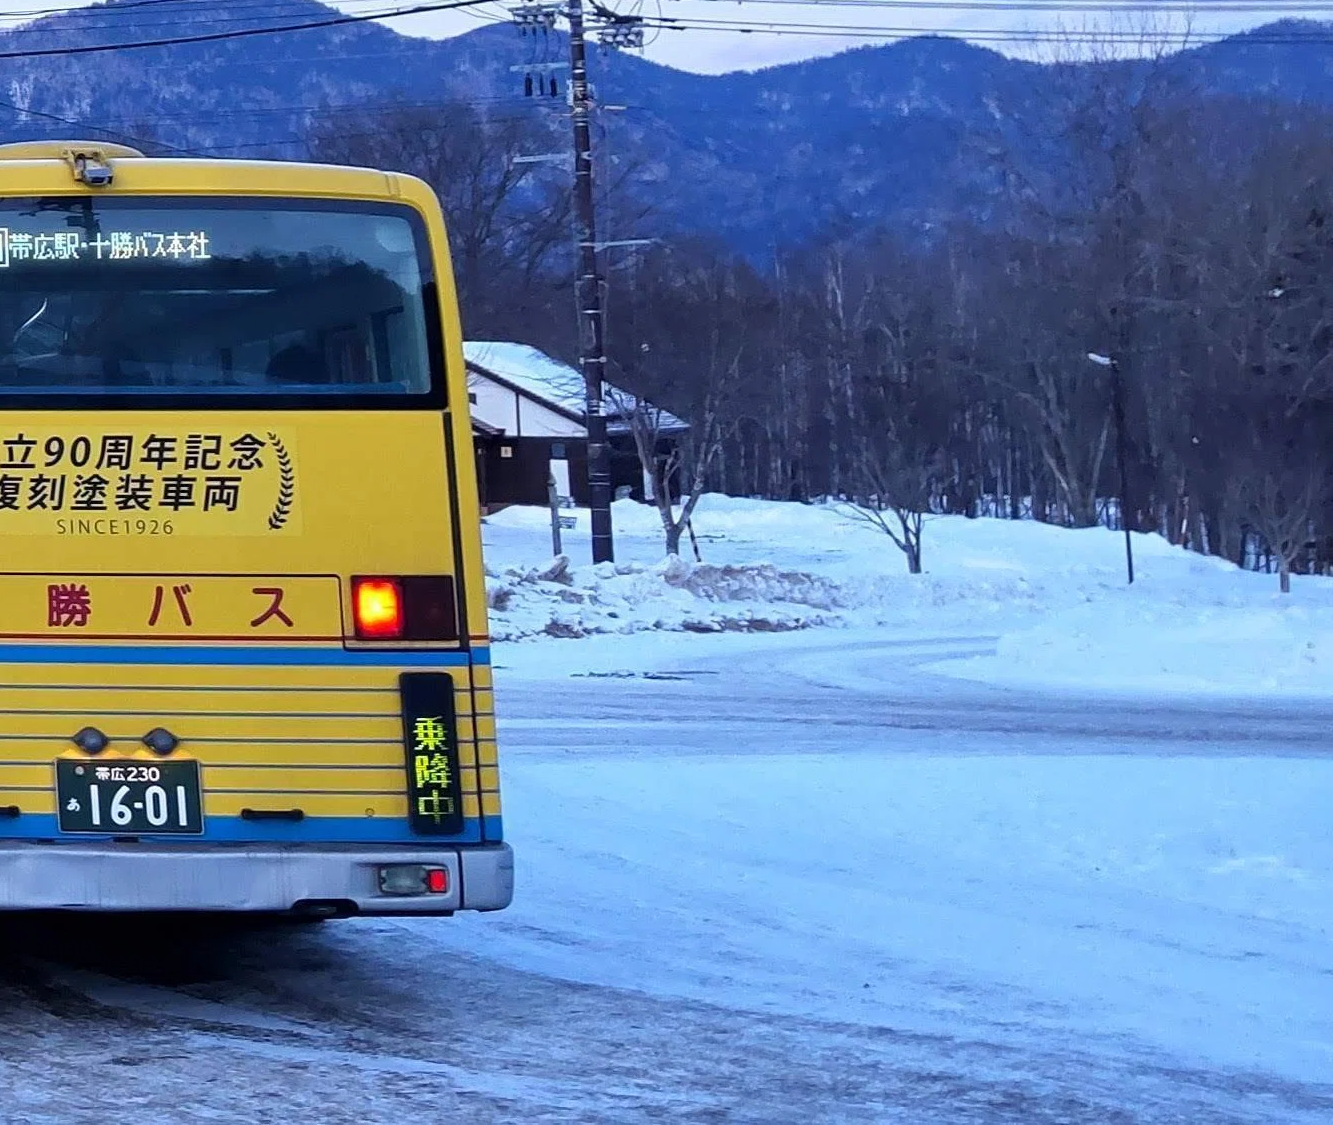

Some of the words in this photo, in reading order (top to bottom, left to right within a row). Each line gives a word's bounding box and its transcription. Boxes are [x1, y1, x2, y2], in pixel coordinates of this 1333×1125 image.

[8, 231, 211, 260] 帯広駅・十勝バス本社
[56, 519, 174, 535] SINCE1926
[413, 715, 454, 825] 乗降中
[66, 797, 81, 812] あ
[89, 784, 187, 826] 16-01
